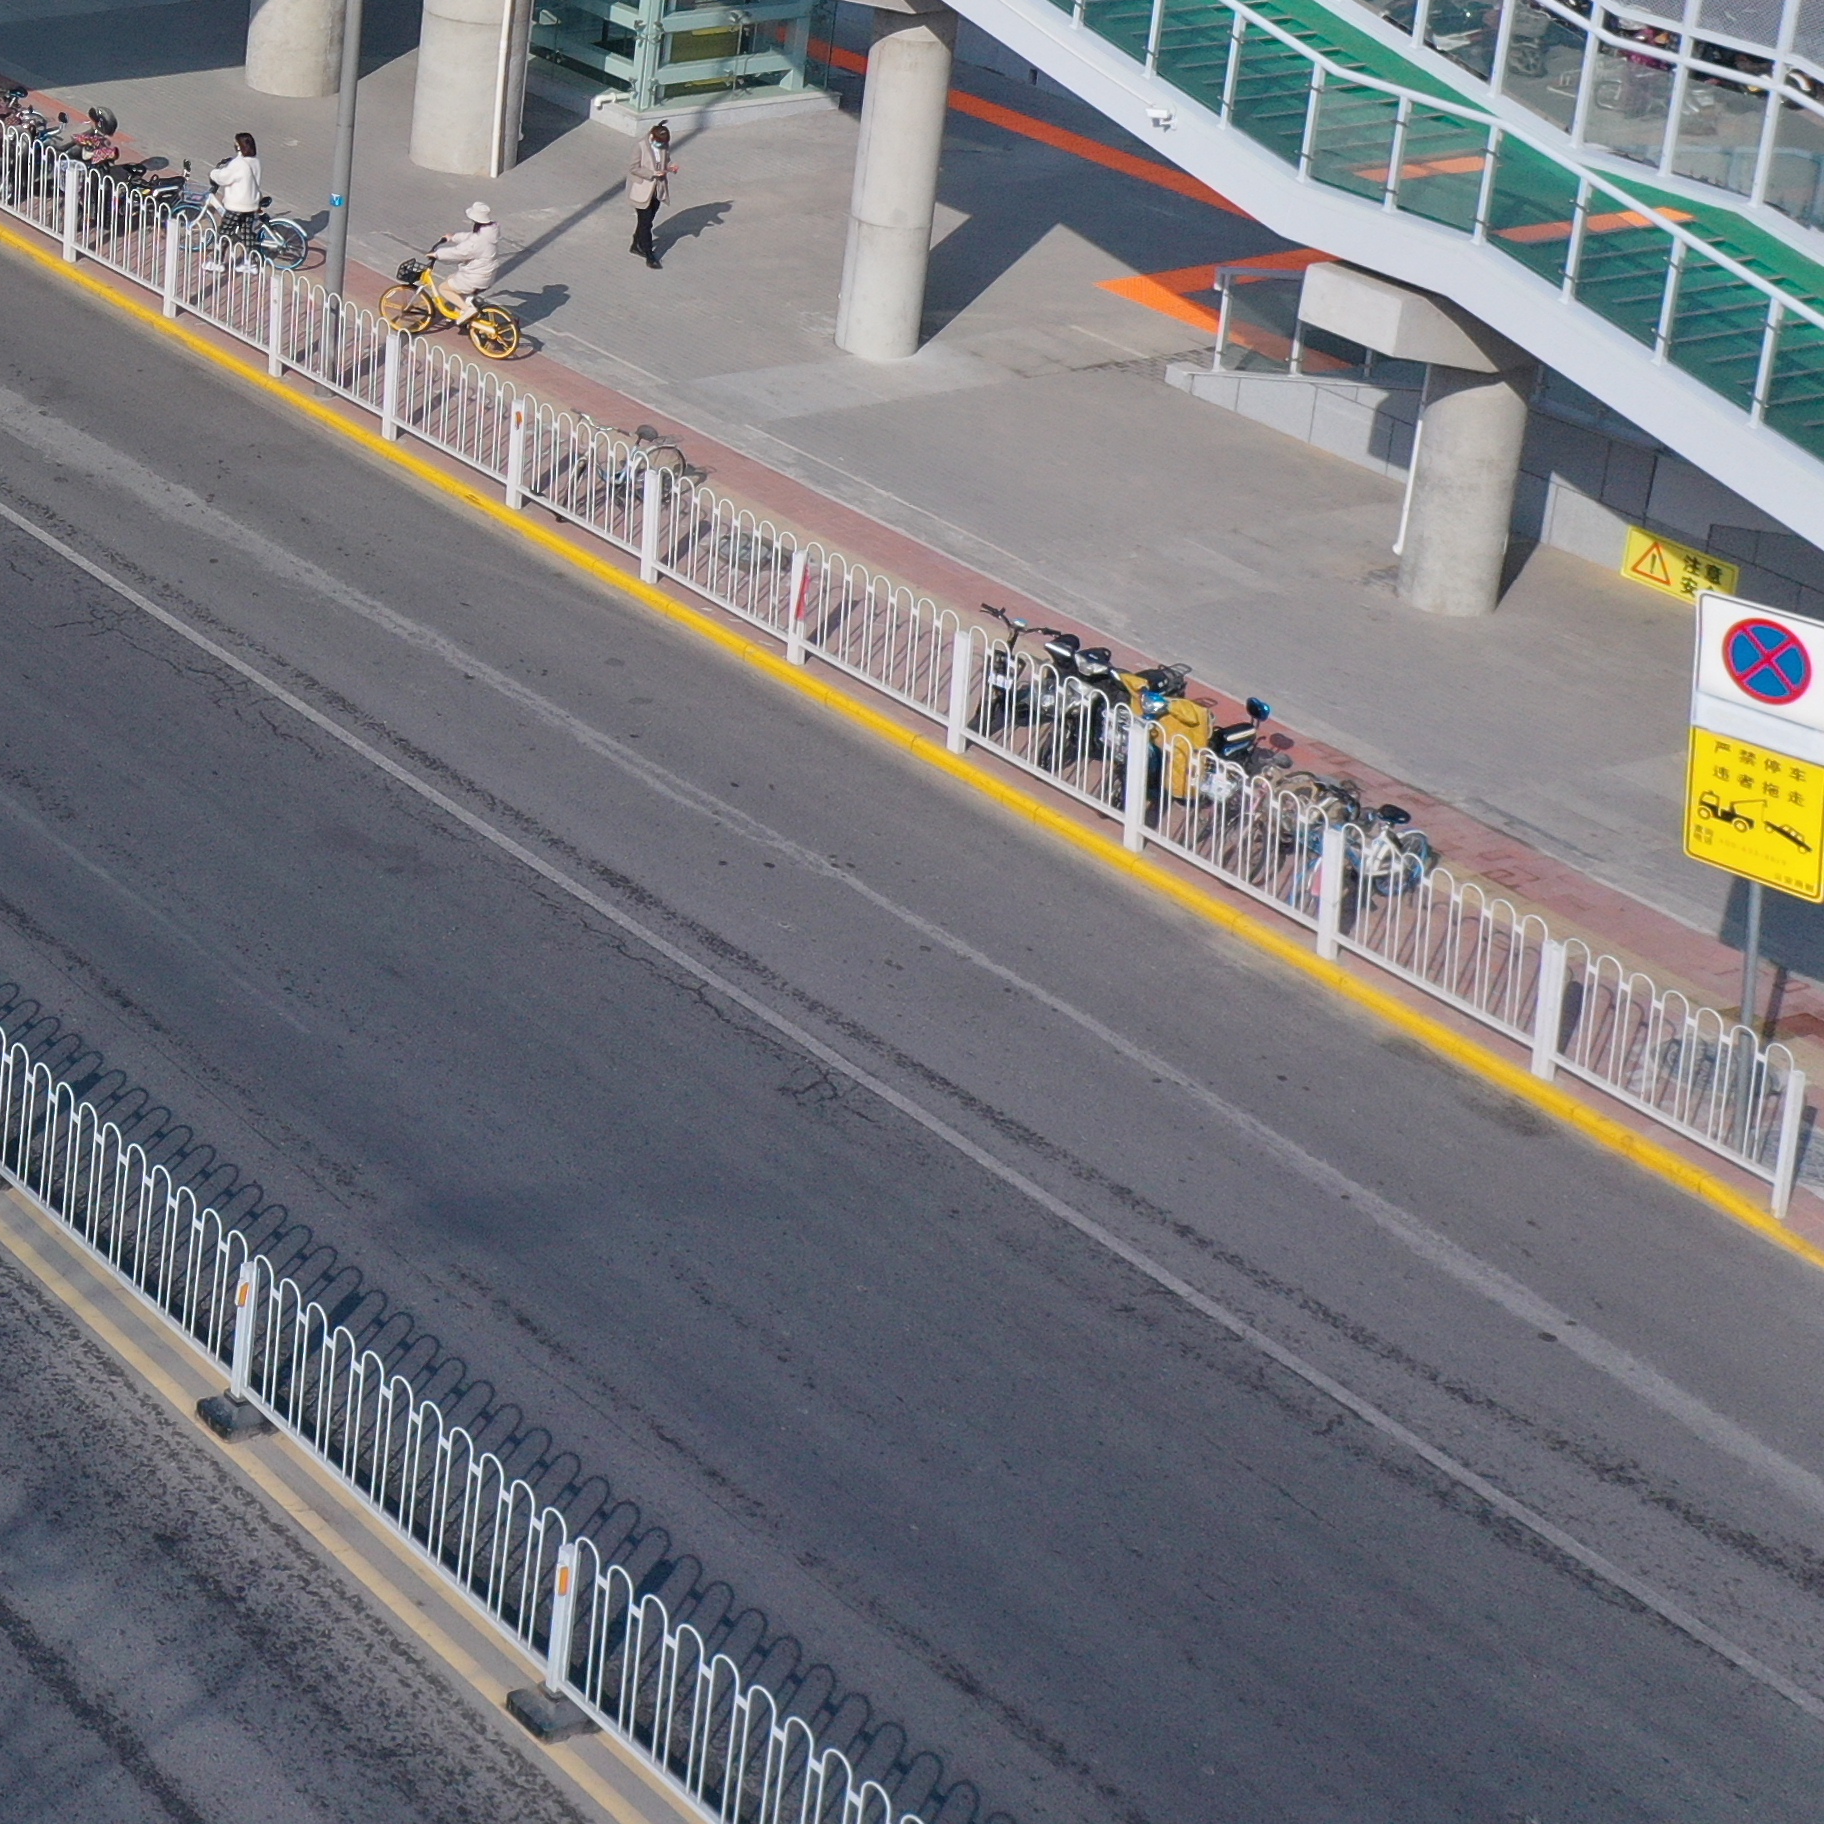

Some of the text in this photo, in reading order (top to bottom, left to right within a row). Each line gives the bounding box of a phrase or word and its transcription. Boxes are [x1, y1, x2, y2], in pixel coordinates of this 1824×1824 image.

[1680, 576, 1714, 597] 安
[1683, 555, 1723, 585] 注意
[1714, 740, 1807, 783] 严禁停车
[1713, 765, 1806, 808] 违者拖走
